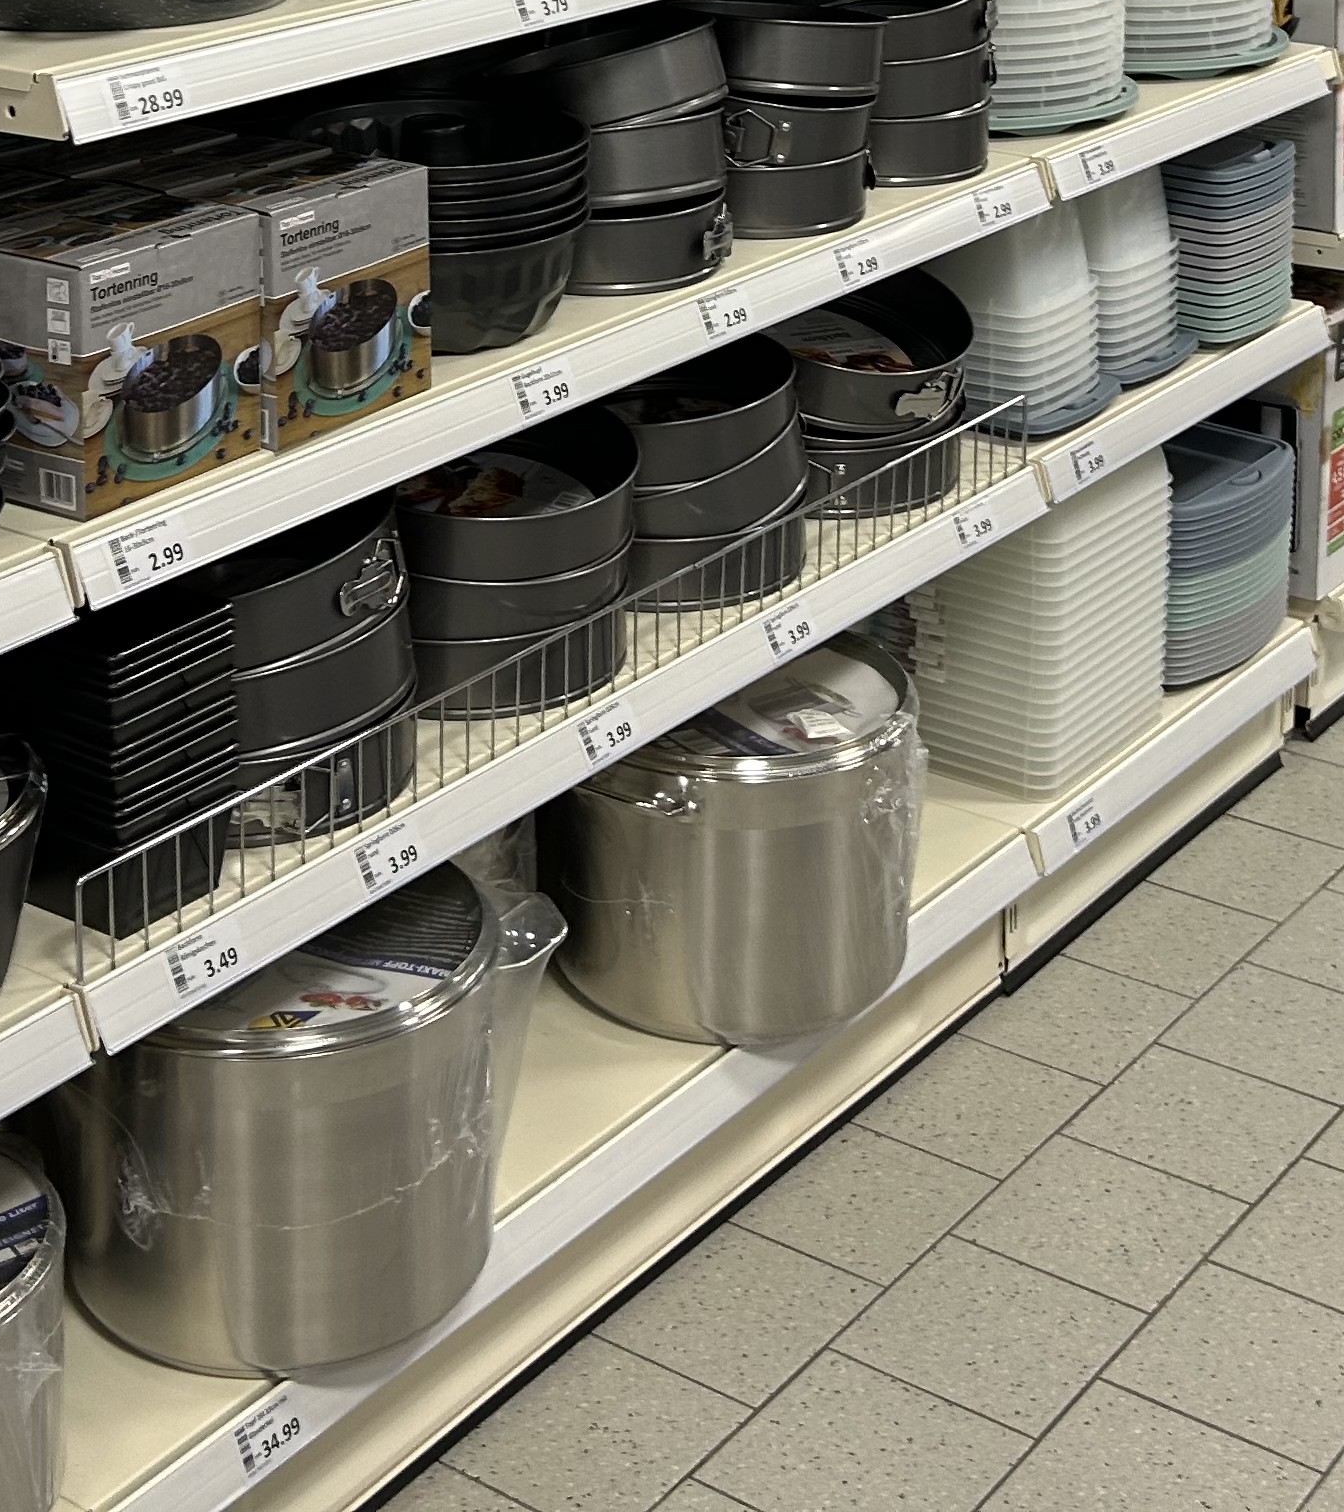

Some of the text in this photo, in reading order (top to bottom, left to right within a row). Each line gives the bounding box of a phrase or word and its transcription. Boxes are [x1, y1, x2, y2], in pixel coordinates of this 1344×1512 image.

[138, 89, 184, 115] 28.99
[993, 202, 1012, 220] 2.99
[280, 219, 339, 247] Tortenring
[857, 257, 878, 276] 2.99
[90, 272, 158, 302] Tortenring
[724, 308, 748, 328] 2.99
[543, 383, 569, 406] 3.99
[148, 543, 184, 571] 2.99
[787, 621, 810, 645] 3.99
[606, 722, 632, 748] 3.99
[388, 844, 417, 874] 3.99
[203, 947, 238, 978] 3.49
[261, 1417, 301, 1459] 34.99
